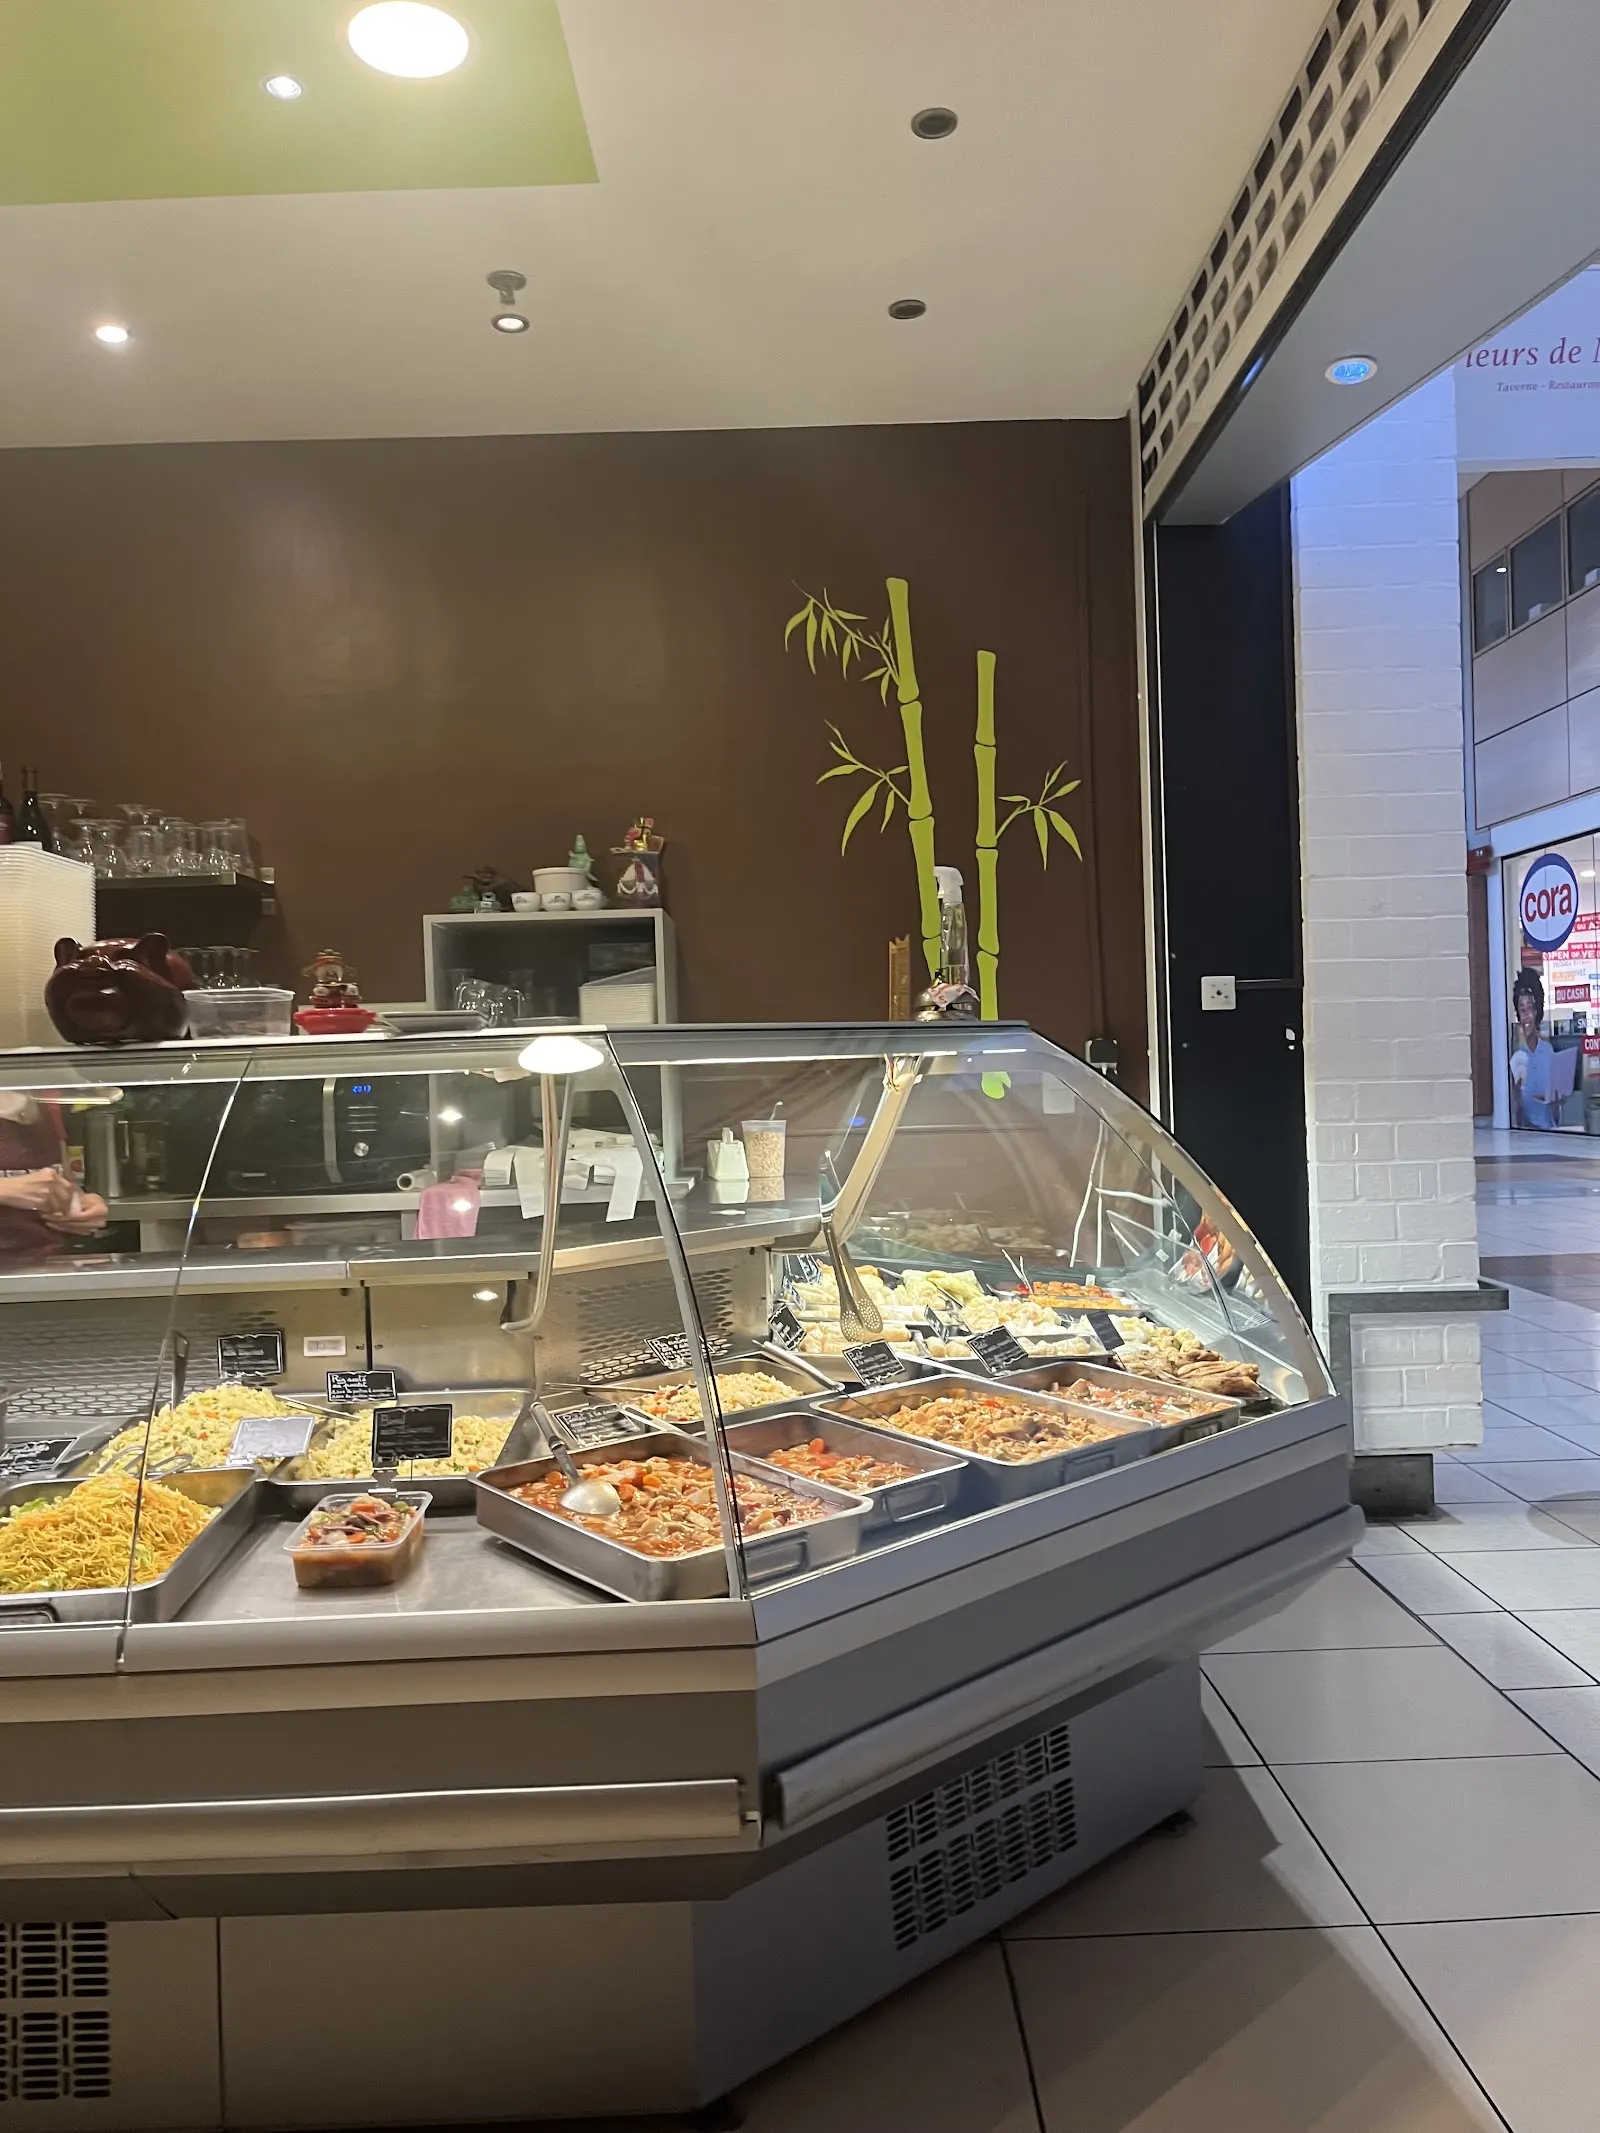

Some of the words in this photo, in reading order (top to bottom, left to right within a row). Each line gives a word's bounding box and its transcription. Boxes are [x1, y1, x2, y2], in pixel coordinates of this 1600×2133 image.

[1549, 337, 1582, 365] de
[1496, 382, 1538, 392] Taverne
[1525, 884, 1572, 922] cora
[1567, 987, 1585, 1000] CASH
